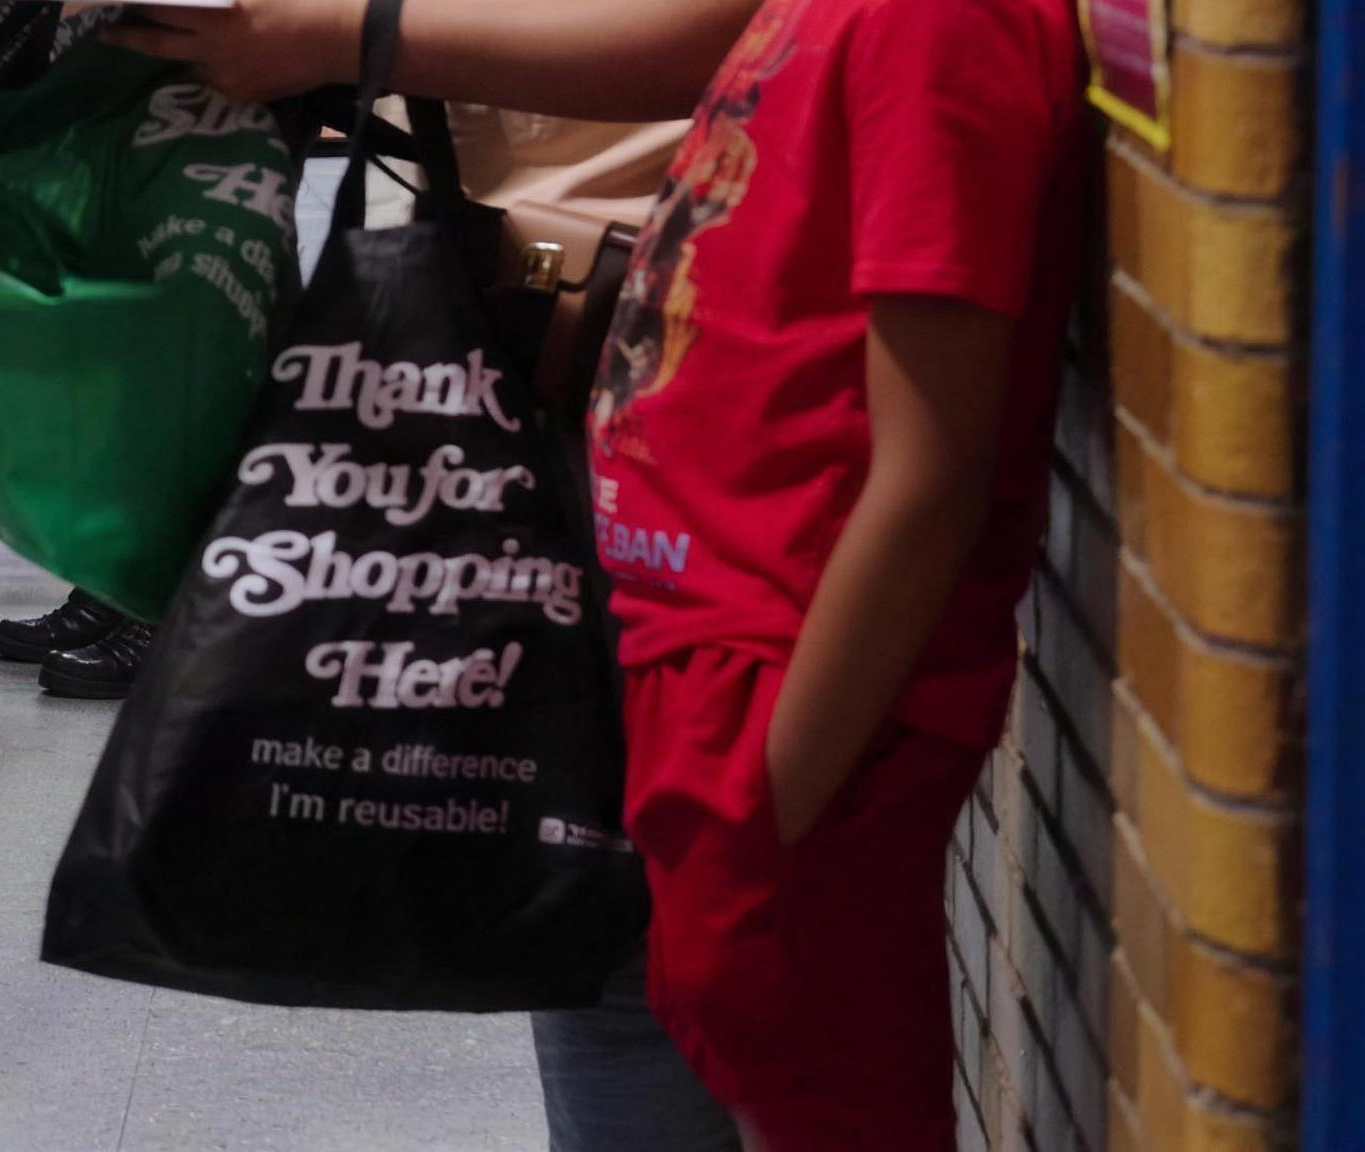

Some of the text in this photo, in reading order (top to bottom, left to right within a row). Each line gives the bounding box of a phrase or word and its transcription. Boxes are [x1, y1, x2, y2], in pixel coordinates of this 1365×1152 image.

[271, 341, 522, 432] Thank
[239, 442, 536, 527] You for
[202, 530, 583, 626] Shopping
[305, 640, 523, 710] Here!
[251, 737, 538, 782] make a difference
[269, 783, 510, 834] I'm reusable!
